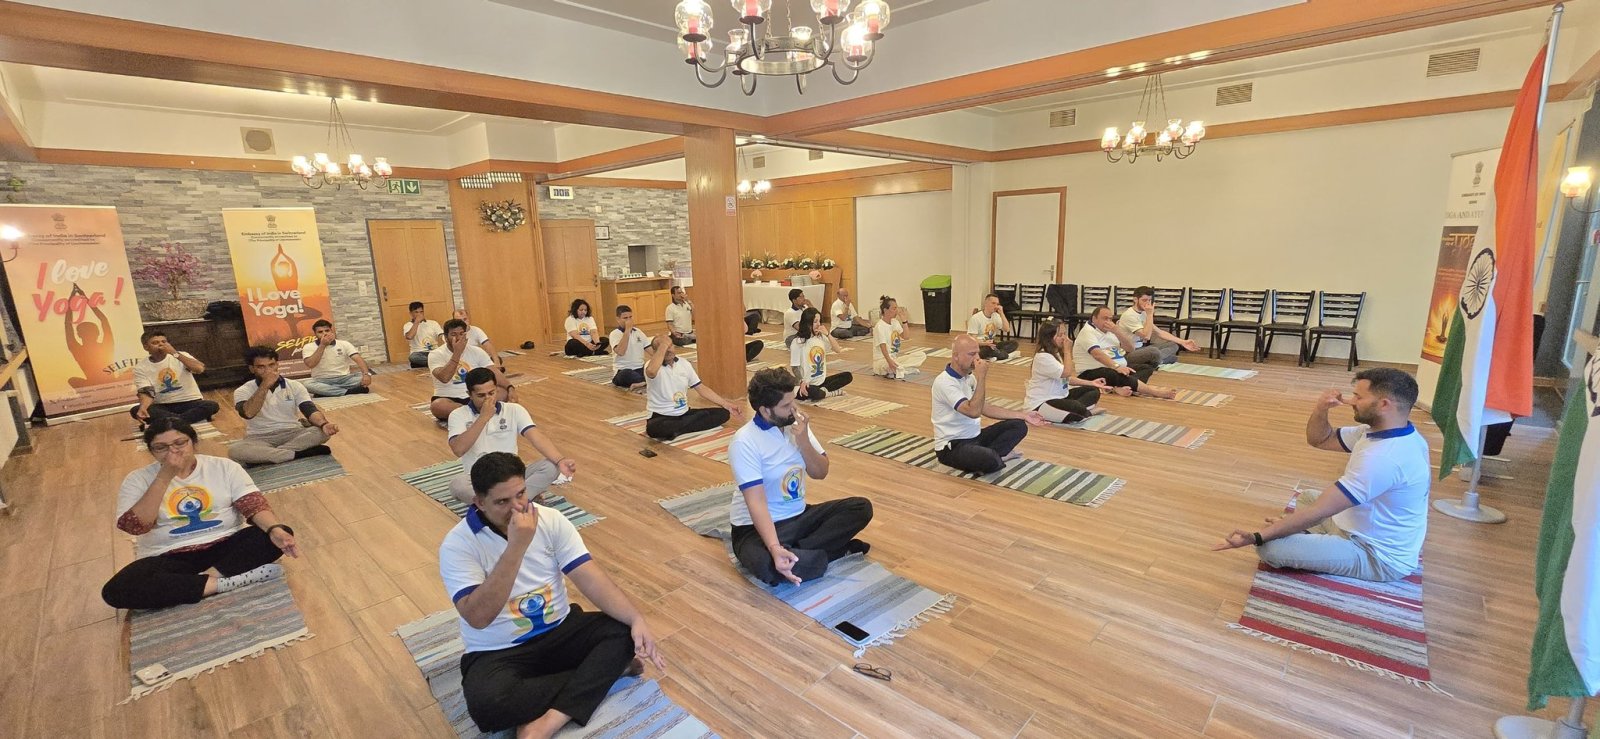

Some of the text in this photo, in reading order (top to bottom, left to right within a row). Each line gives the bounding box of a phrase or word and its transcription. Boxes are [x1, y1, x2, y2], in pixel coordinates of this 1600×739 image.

[37, 259, 109, 289] I love
[247, 287, 301, 302] I Love
[32, 291, 106, 324] Yoga
[248, 299, 305, 319] Yoga!
